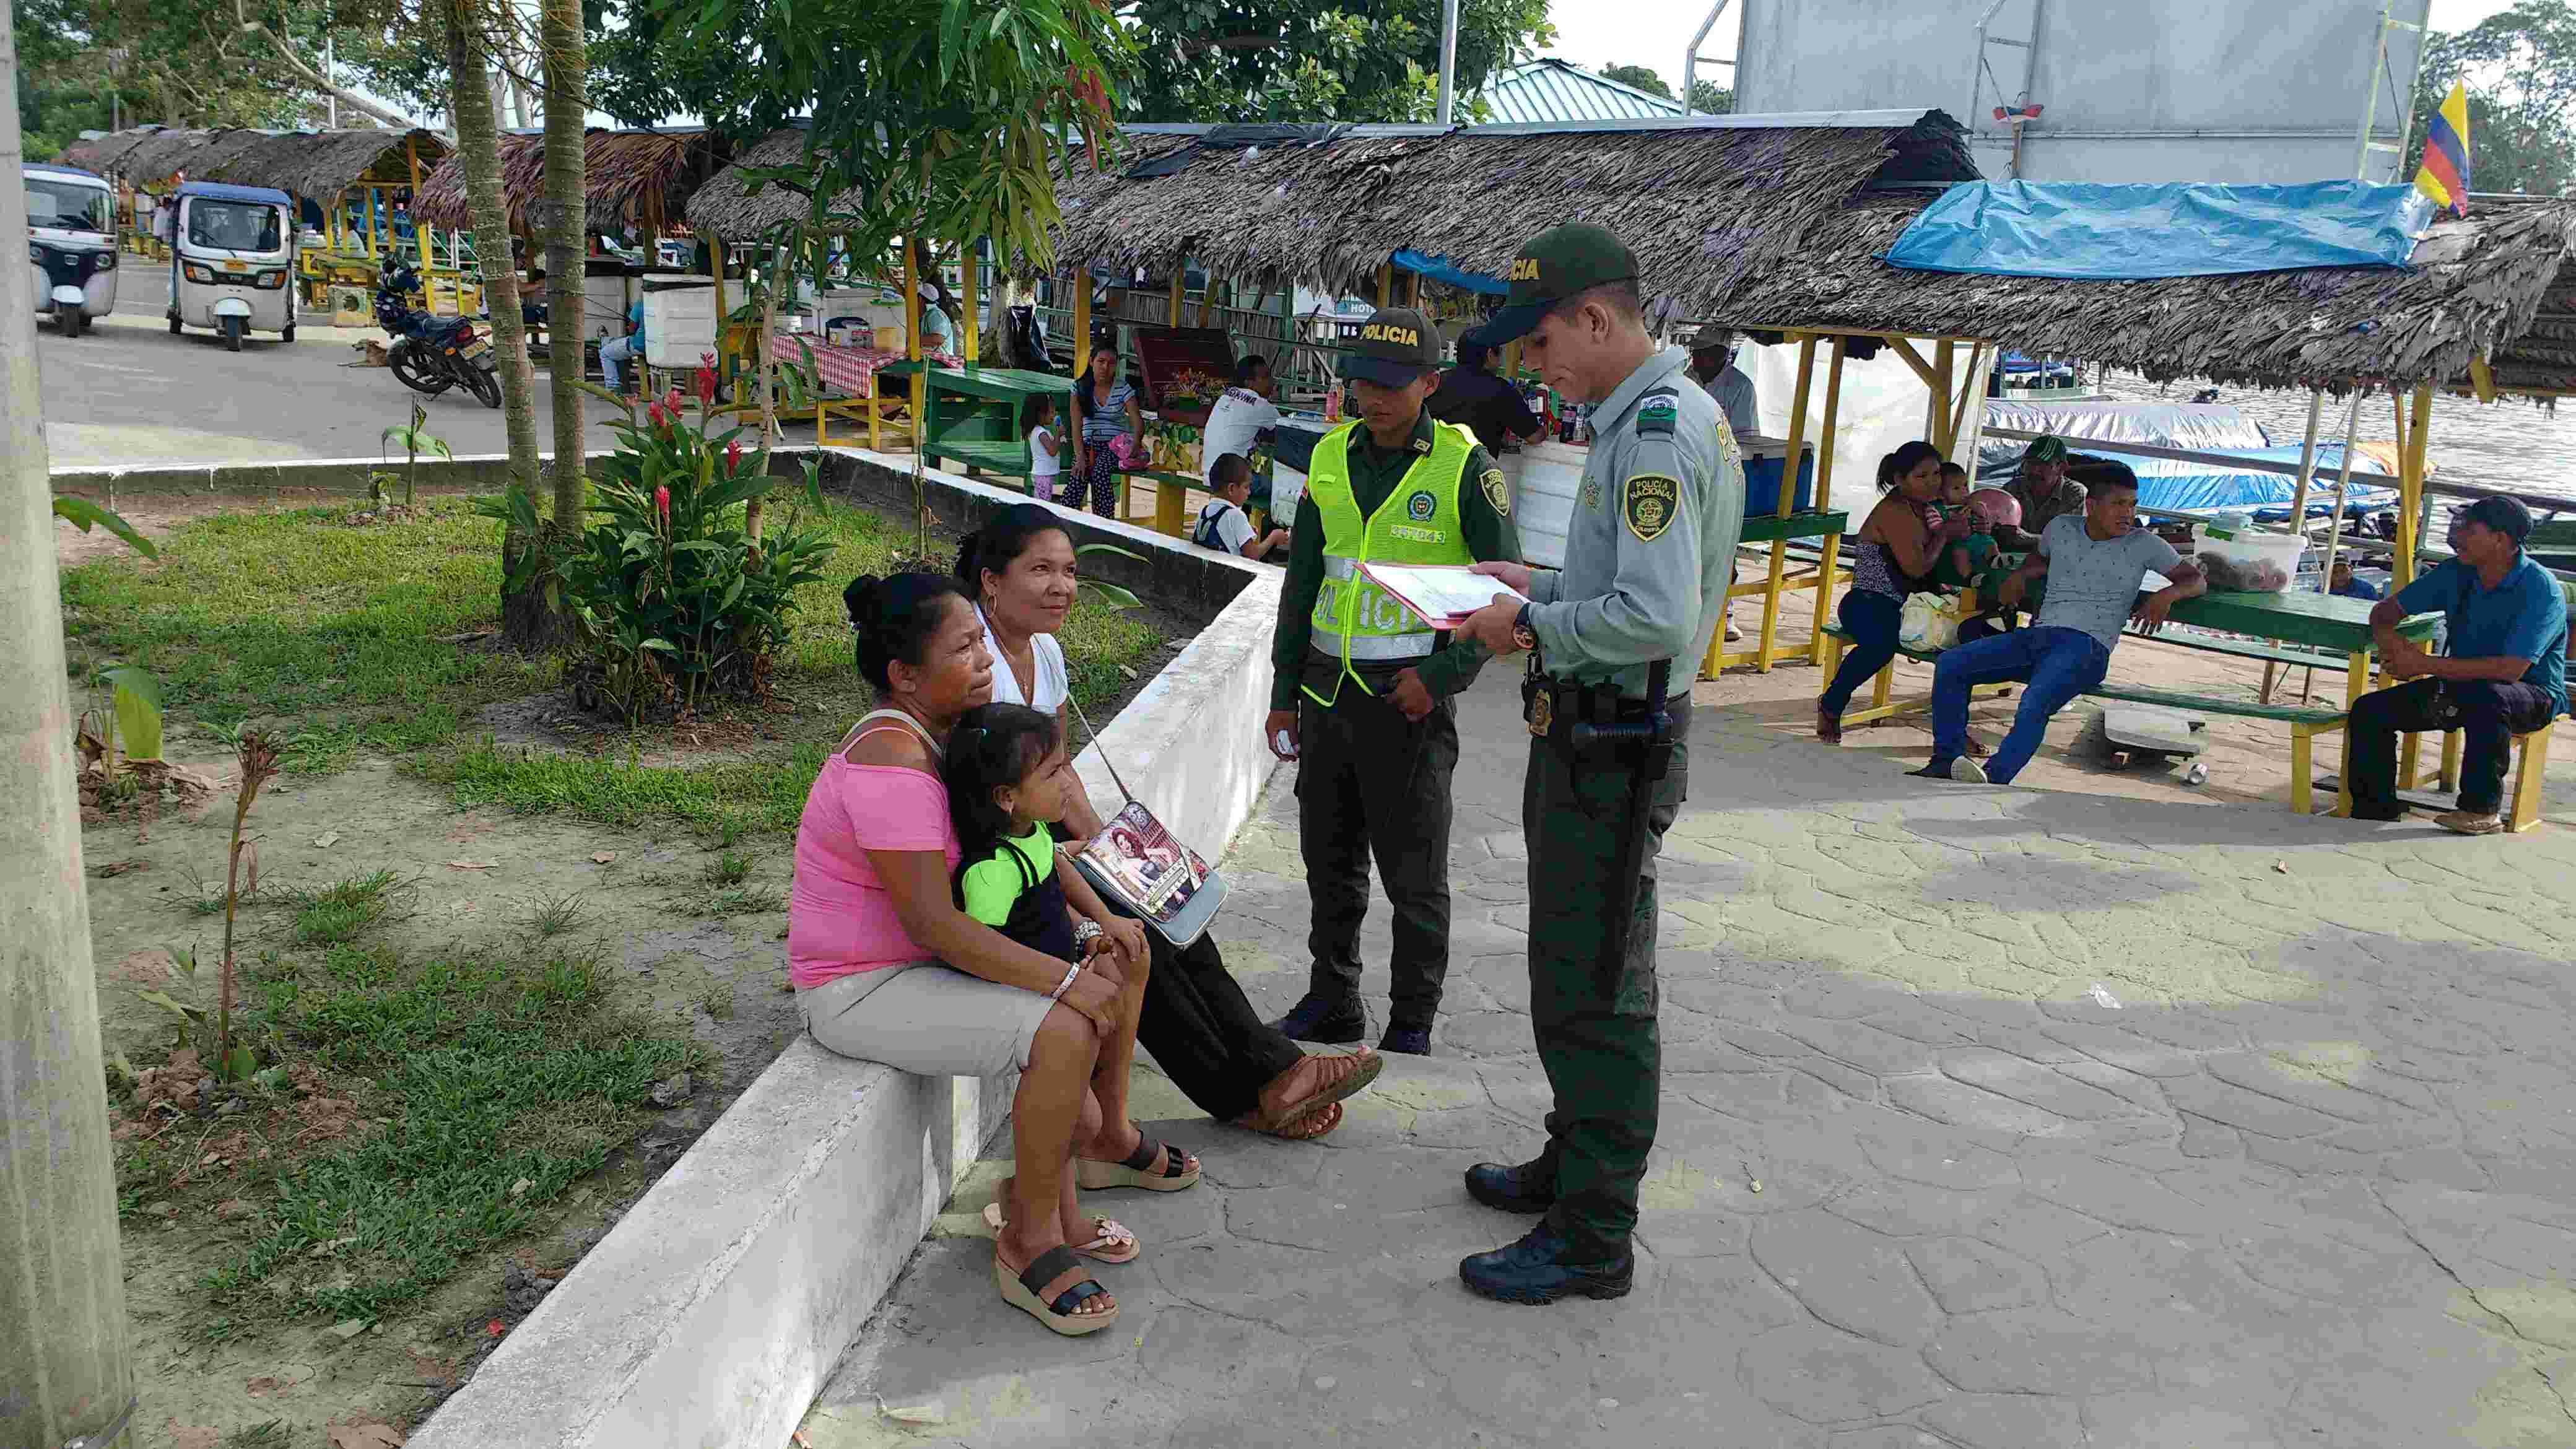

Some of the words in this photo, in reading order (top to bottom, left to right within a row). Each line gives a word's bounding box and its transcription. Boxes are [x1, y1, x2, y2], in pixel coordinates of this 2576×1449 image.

[1510, 259, 1540, 280] CIA
[1351, 302, 1376, 313] HOT
[1360, 323, 1418, 347] POLICIA
[1630, 485, 1674, 501] NACIONAL
[1316, 583, 1430, 630] OLICI
